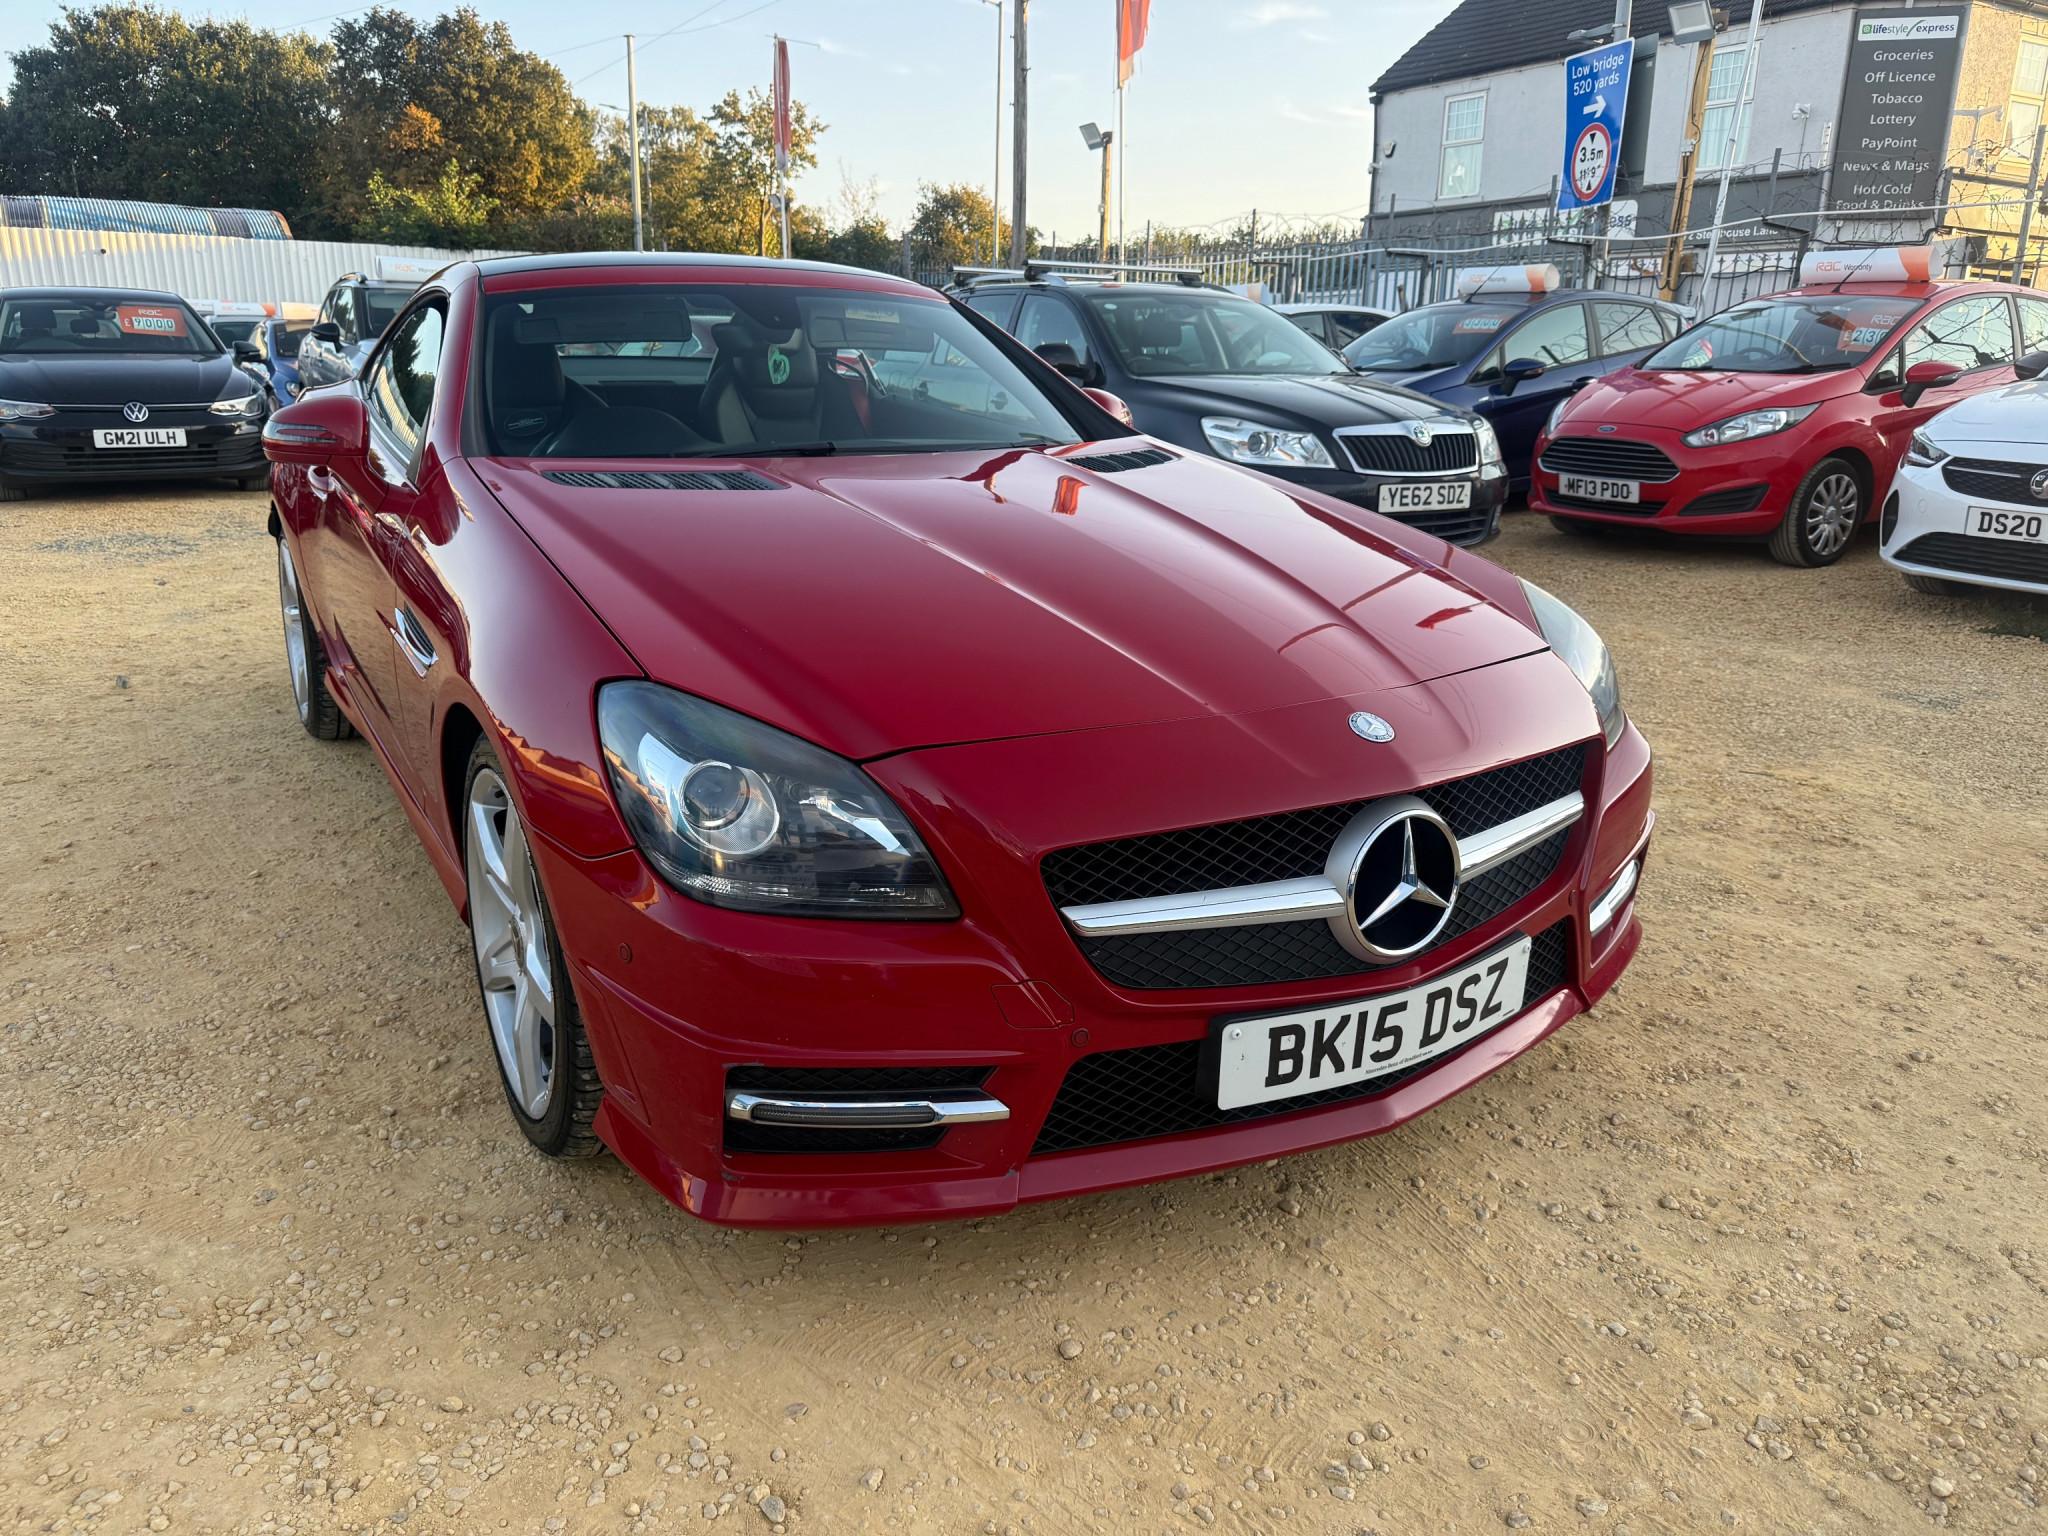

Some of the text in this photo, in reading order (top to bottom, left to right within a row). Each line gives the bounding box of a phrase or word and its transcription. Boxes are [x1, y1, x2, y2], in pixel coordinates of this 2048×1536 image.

[1872, 24, 1955, 35] lifestyle express
[1873, 49, 1935, 61] Groceries
[1572, 53, 1625, 80] Low bridge
[1573, 71, 1620, 96] 520 yards
[1864, 71, 1936, 83] Off Licence
[1871, 93, 1923, 104] Tobacco
[1870, 114, 1917, 127] Lottery
[1861, 137, 1917, 151] PayPoint
[1580, 146, 1604, 163] 3.5m
[1843, 160, 1929, 174] News & Mags
[1853, 184, 1913, 195] Hot/Cold
[1835, 199, 1868, 210] Food
[1870, 200, 1880, 209] &
[1816, 261, 1841, 272] RAC
[103, 431, 177, 446] GM21 ULH
[1567, 477, 1630, 499] MF13 PDO
[1388, 484, 1466, 507] YE62 SDZ
[1977, 511, 2042, 538] DS20
[1264, 957, 1509, 1088] BK15 DSZ
